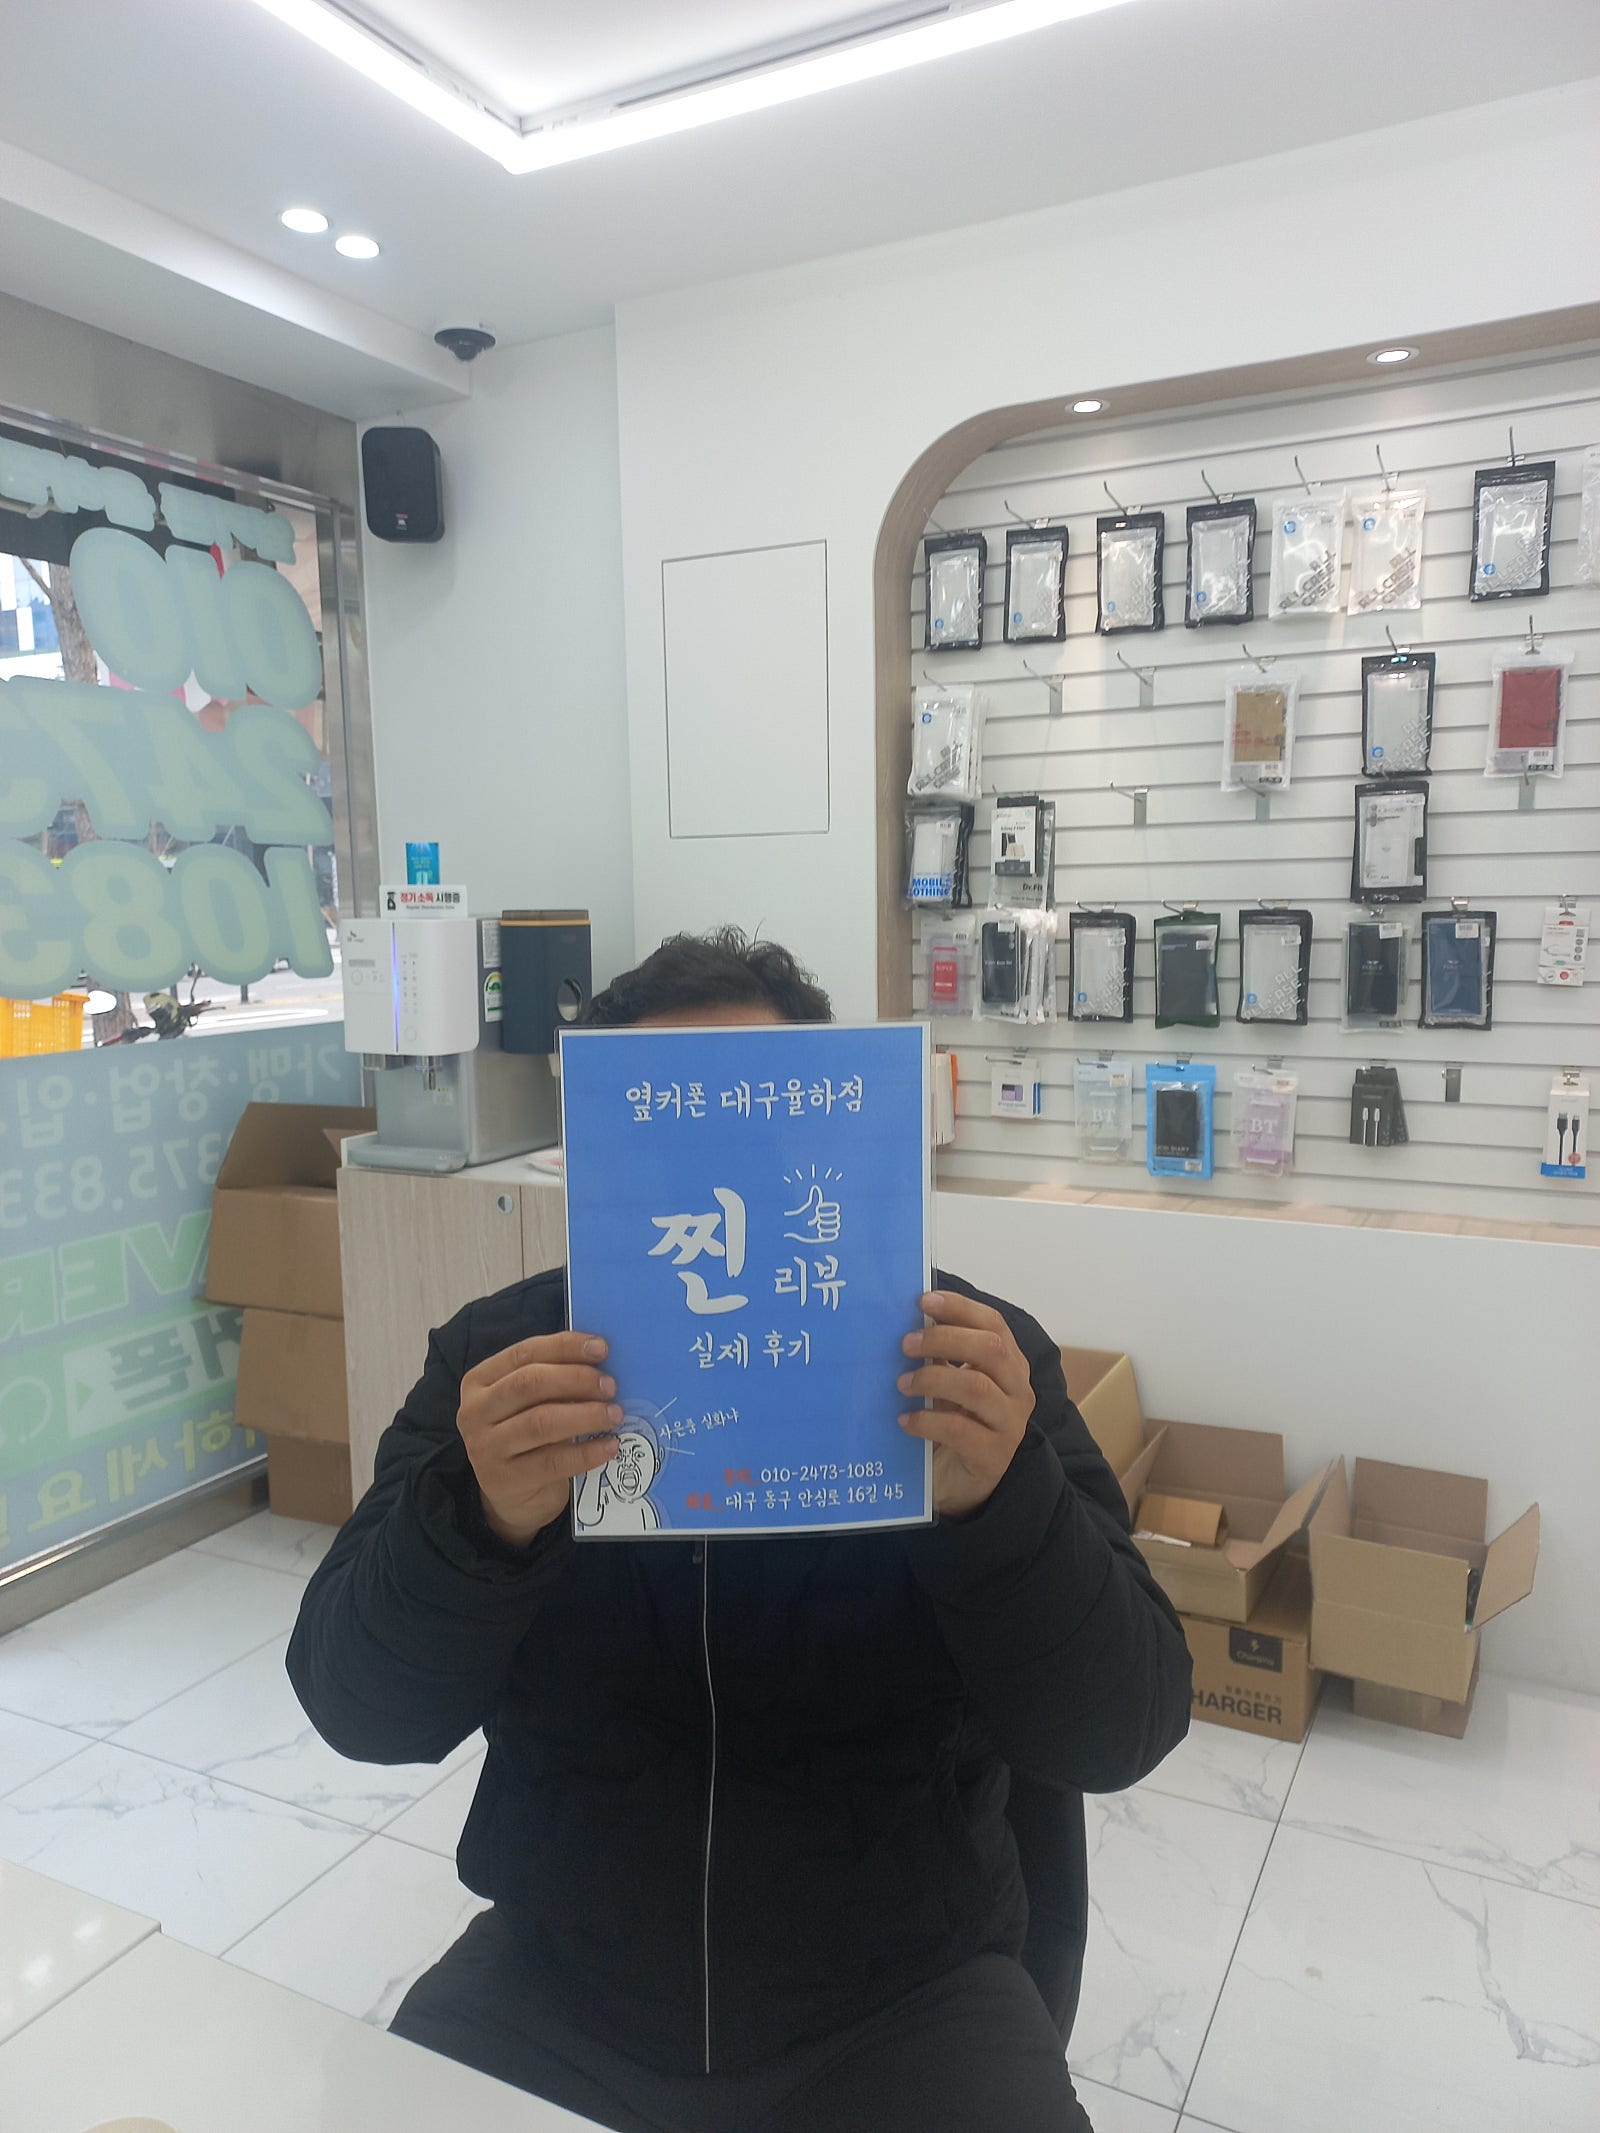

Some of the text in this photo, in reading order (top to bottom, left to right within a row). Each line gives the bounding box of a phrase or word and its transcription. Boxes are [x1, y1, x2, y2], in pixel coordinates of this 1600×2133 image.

[625, 1074, 865, 1122] 옆커폰 대구율하점
[1250, 1118, 1278, 1134] BT
[646, 1186, 749, 1316] 찐
[773, 1254, 847, 1311] 리뷰
[688, 1329, 812, 1369] 실제 후기
[760, 1460, 884, 1485] 010-2473-1083
[725, 1489, 757, 1512] 대구
[765, 1489, 791, 1511] 동구
[798, 1487, 841, 1509] 안심로
[847, 1484, 878, 1505] 16길
[884, 1482, 904, 1501] 45
